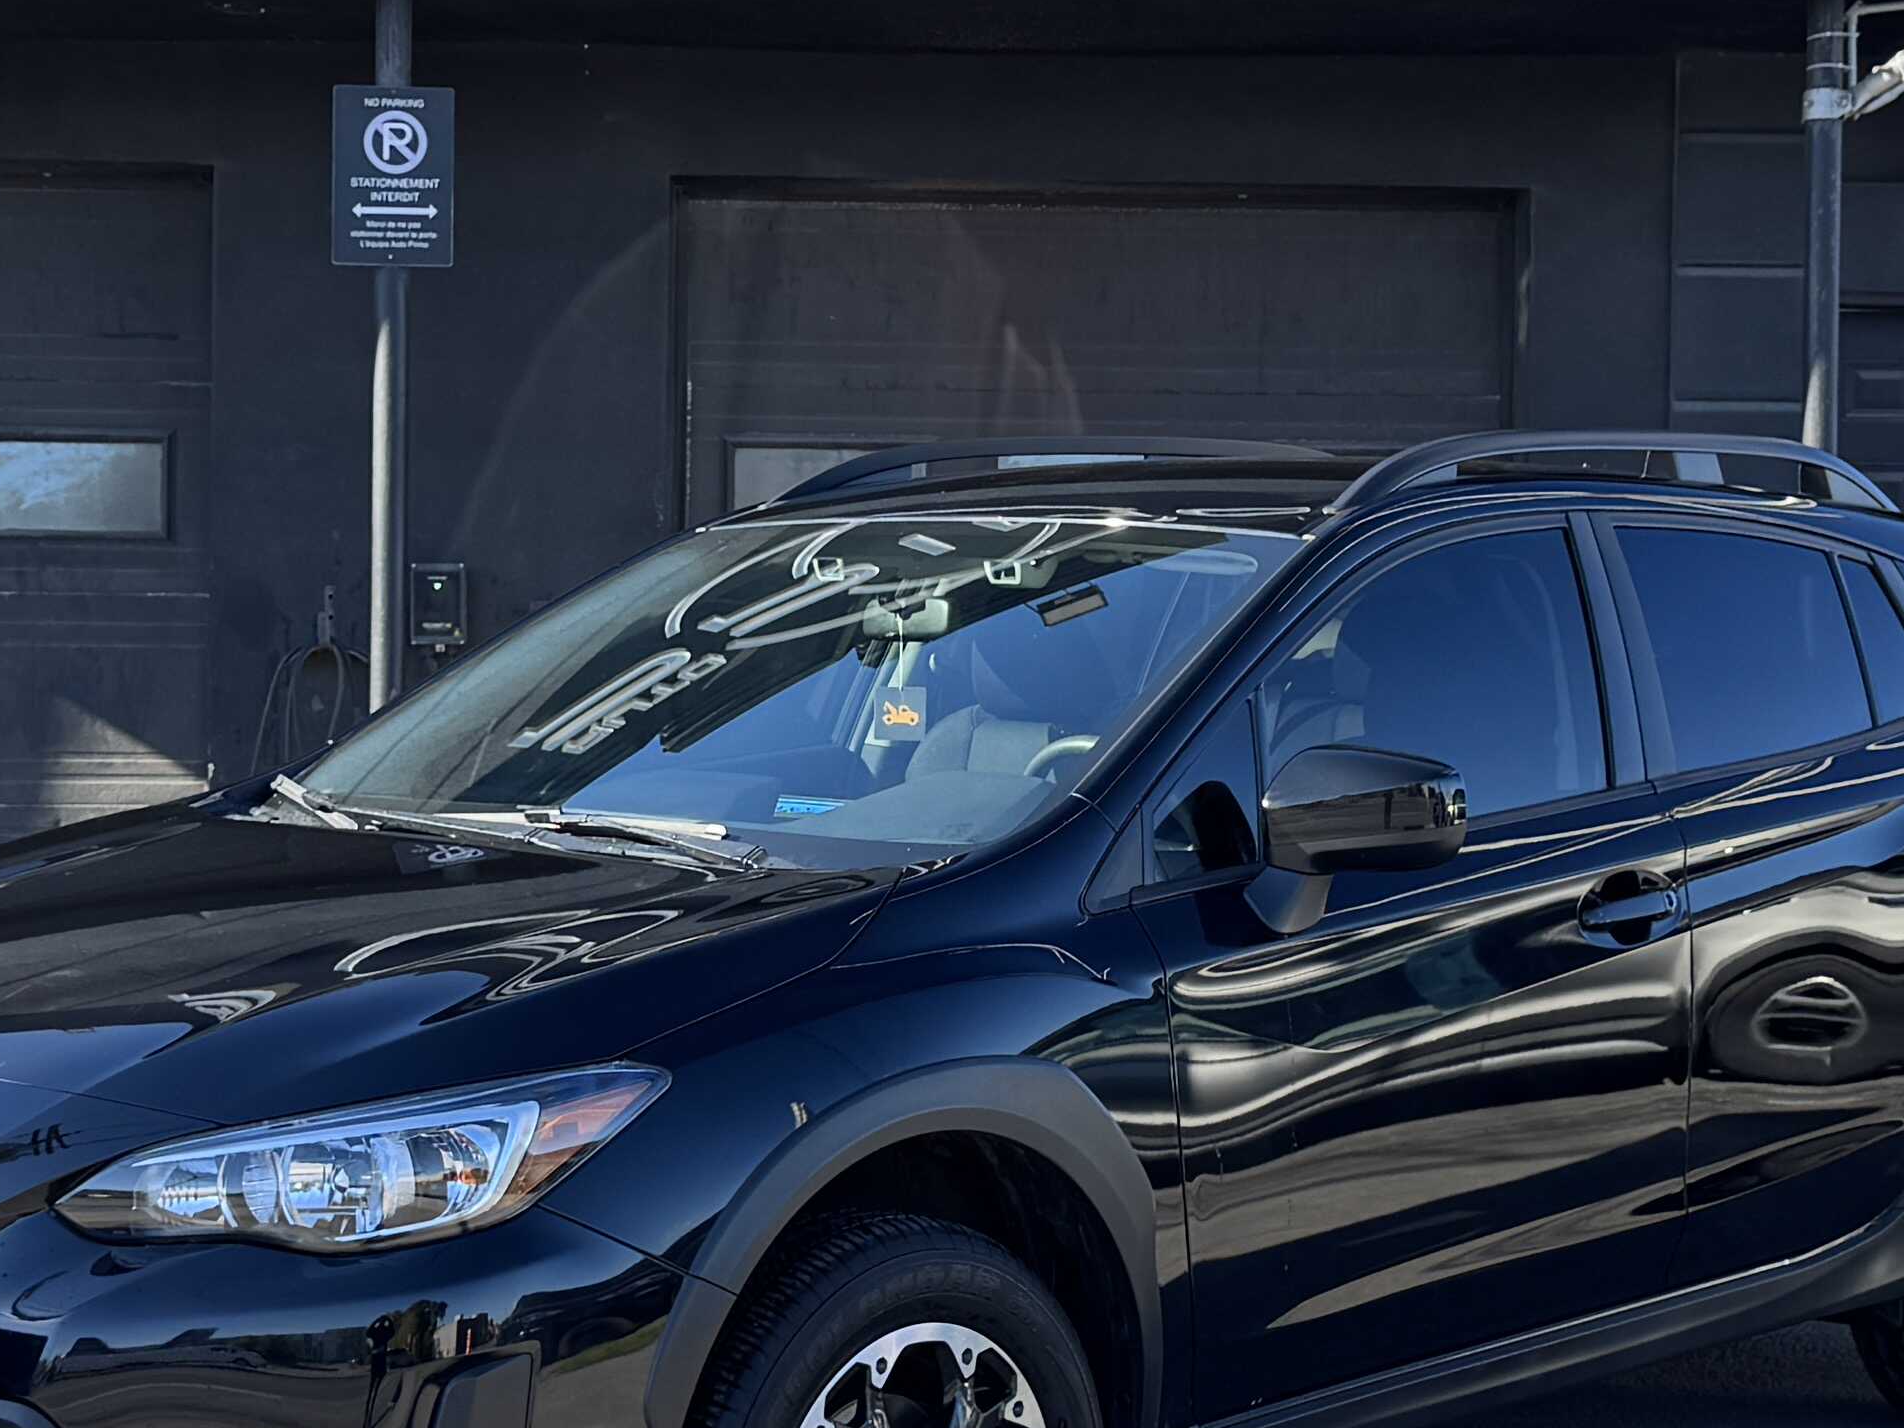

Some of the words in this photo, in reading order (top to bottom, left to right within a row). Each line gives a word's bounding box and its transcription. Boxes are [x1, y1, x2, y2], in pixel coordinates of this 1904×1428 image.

[381, 98, 425, 109] PARKING
[350, 177, 440, 189] STATIONNEMENT
[370, 191, 420, 202] INTERDIT
